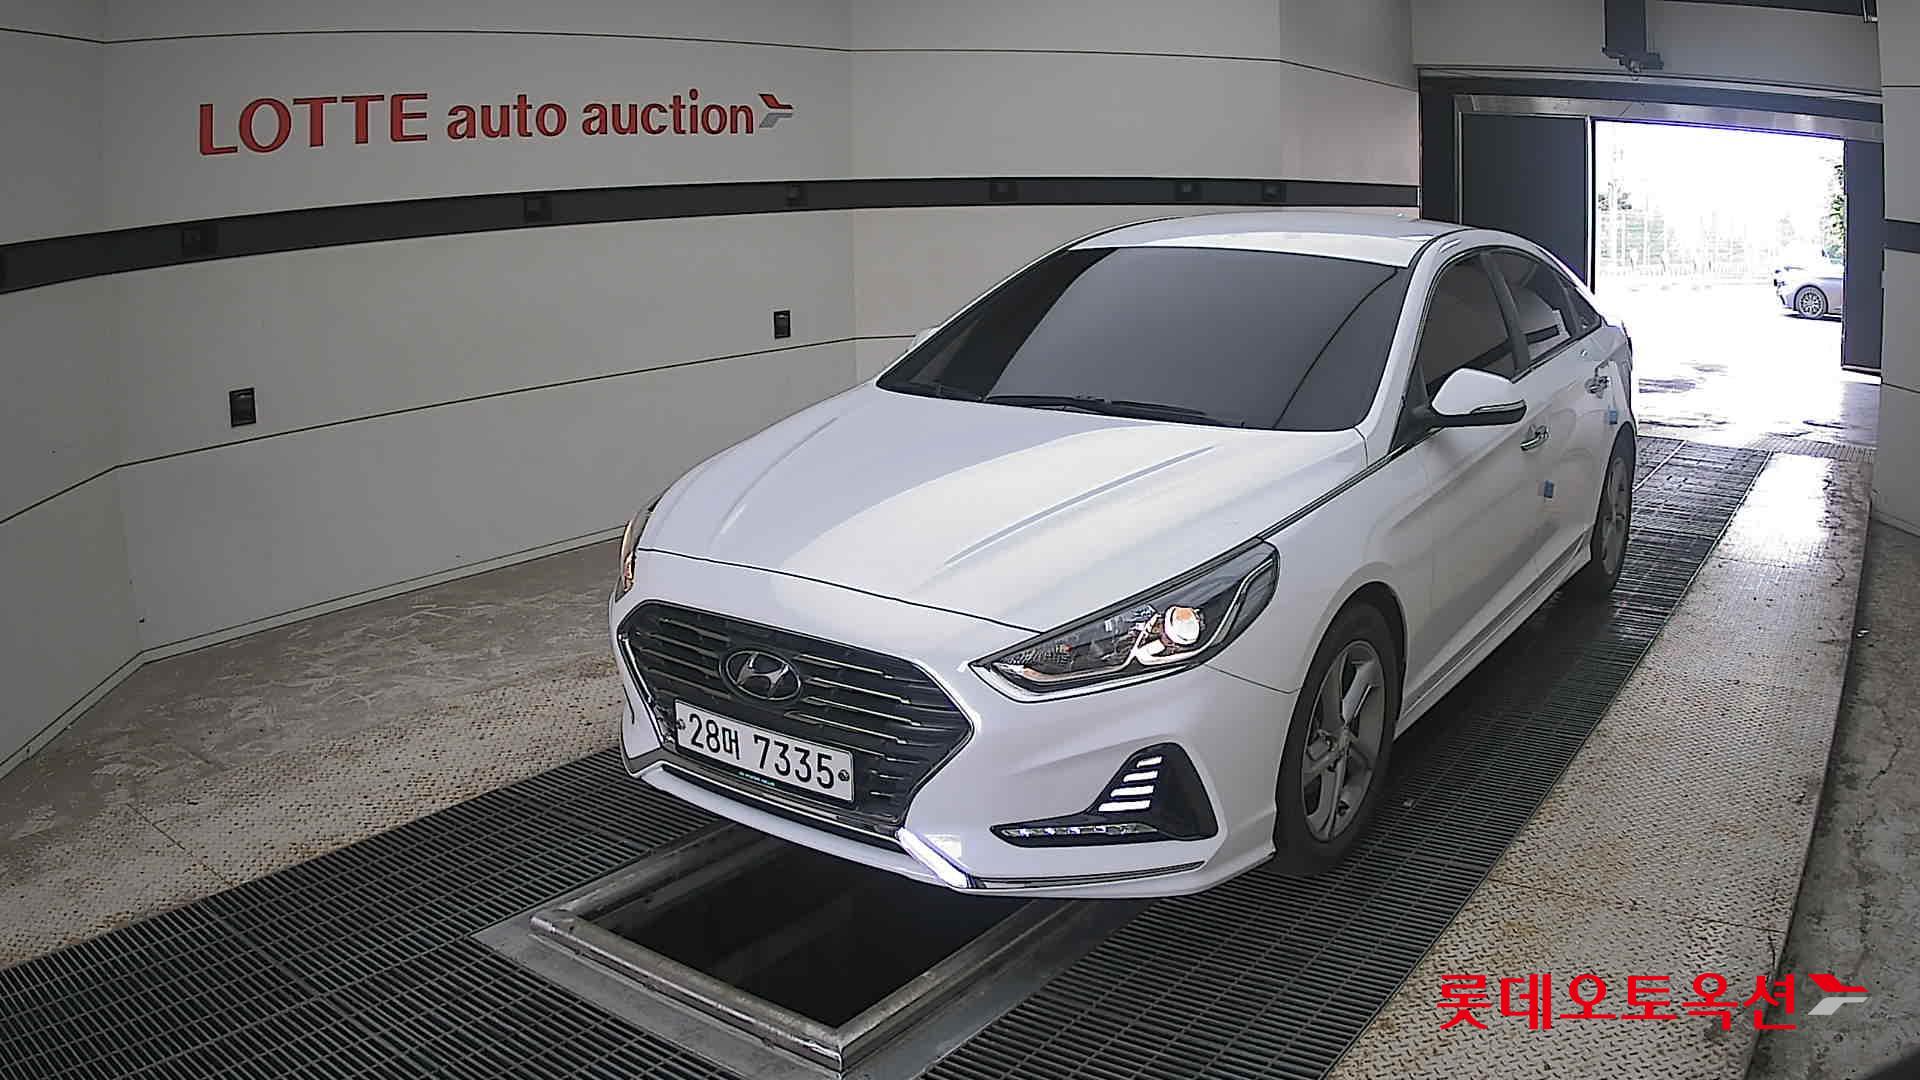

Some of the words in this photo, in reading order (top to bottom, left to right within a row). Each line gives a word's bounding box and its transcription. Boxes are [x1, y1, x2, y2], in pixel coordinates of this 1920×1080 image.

[199, 94, 429, 156] LOTTE
[447, 95, 567, 139] auto
[582, 89, 755, 135] auction
[689, 713, 741, 761] 28머
[752, 733, 835, 790] 7335
